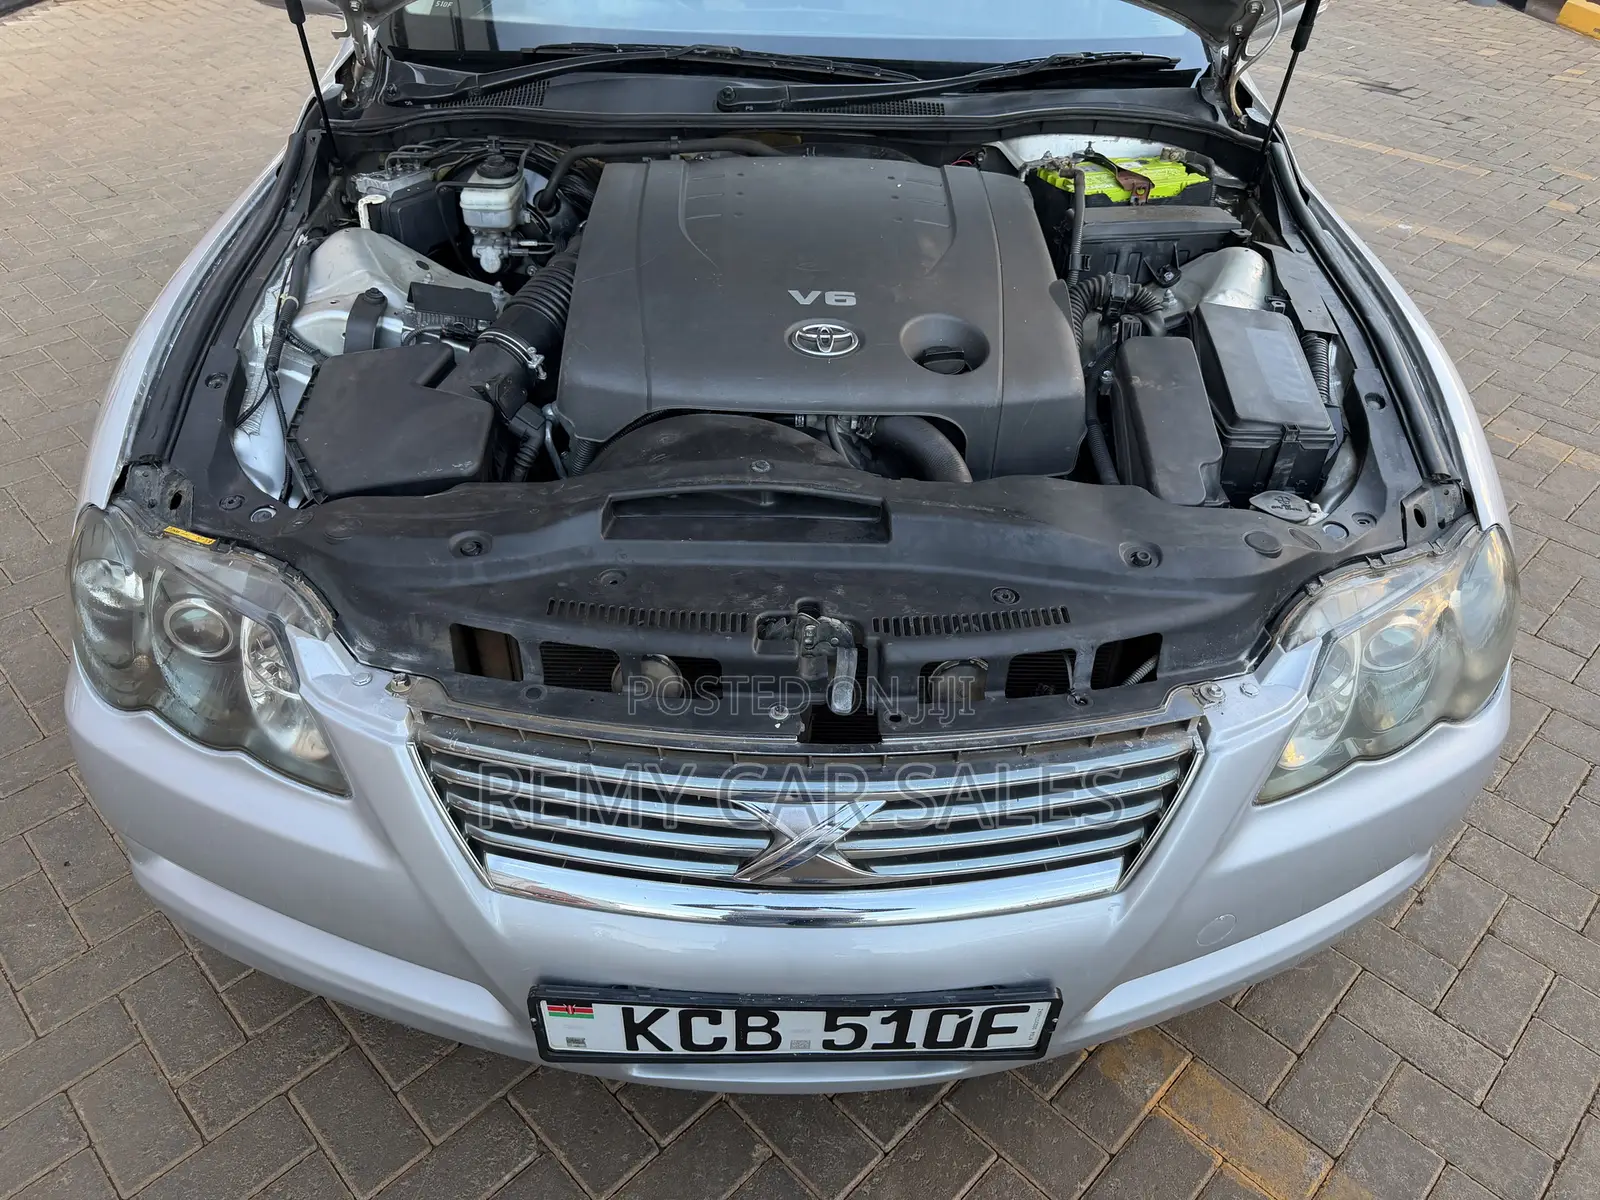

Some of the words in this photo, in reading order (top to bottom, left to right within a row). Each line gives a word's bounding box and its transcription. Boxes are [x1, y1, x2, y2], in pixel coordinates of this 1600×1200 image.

[787, 290, 857, 307] V6
[621, 1006, 783, 1052] KCB
[821, 1005, 1032, 1050] 510F
